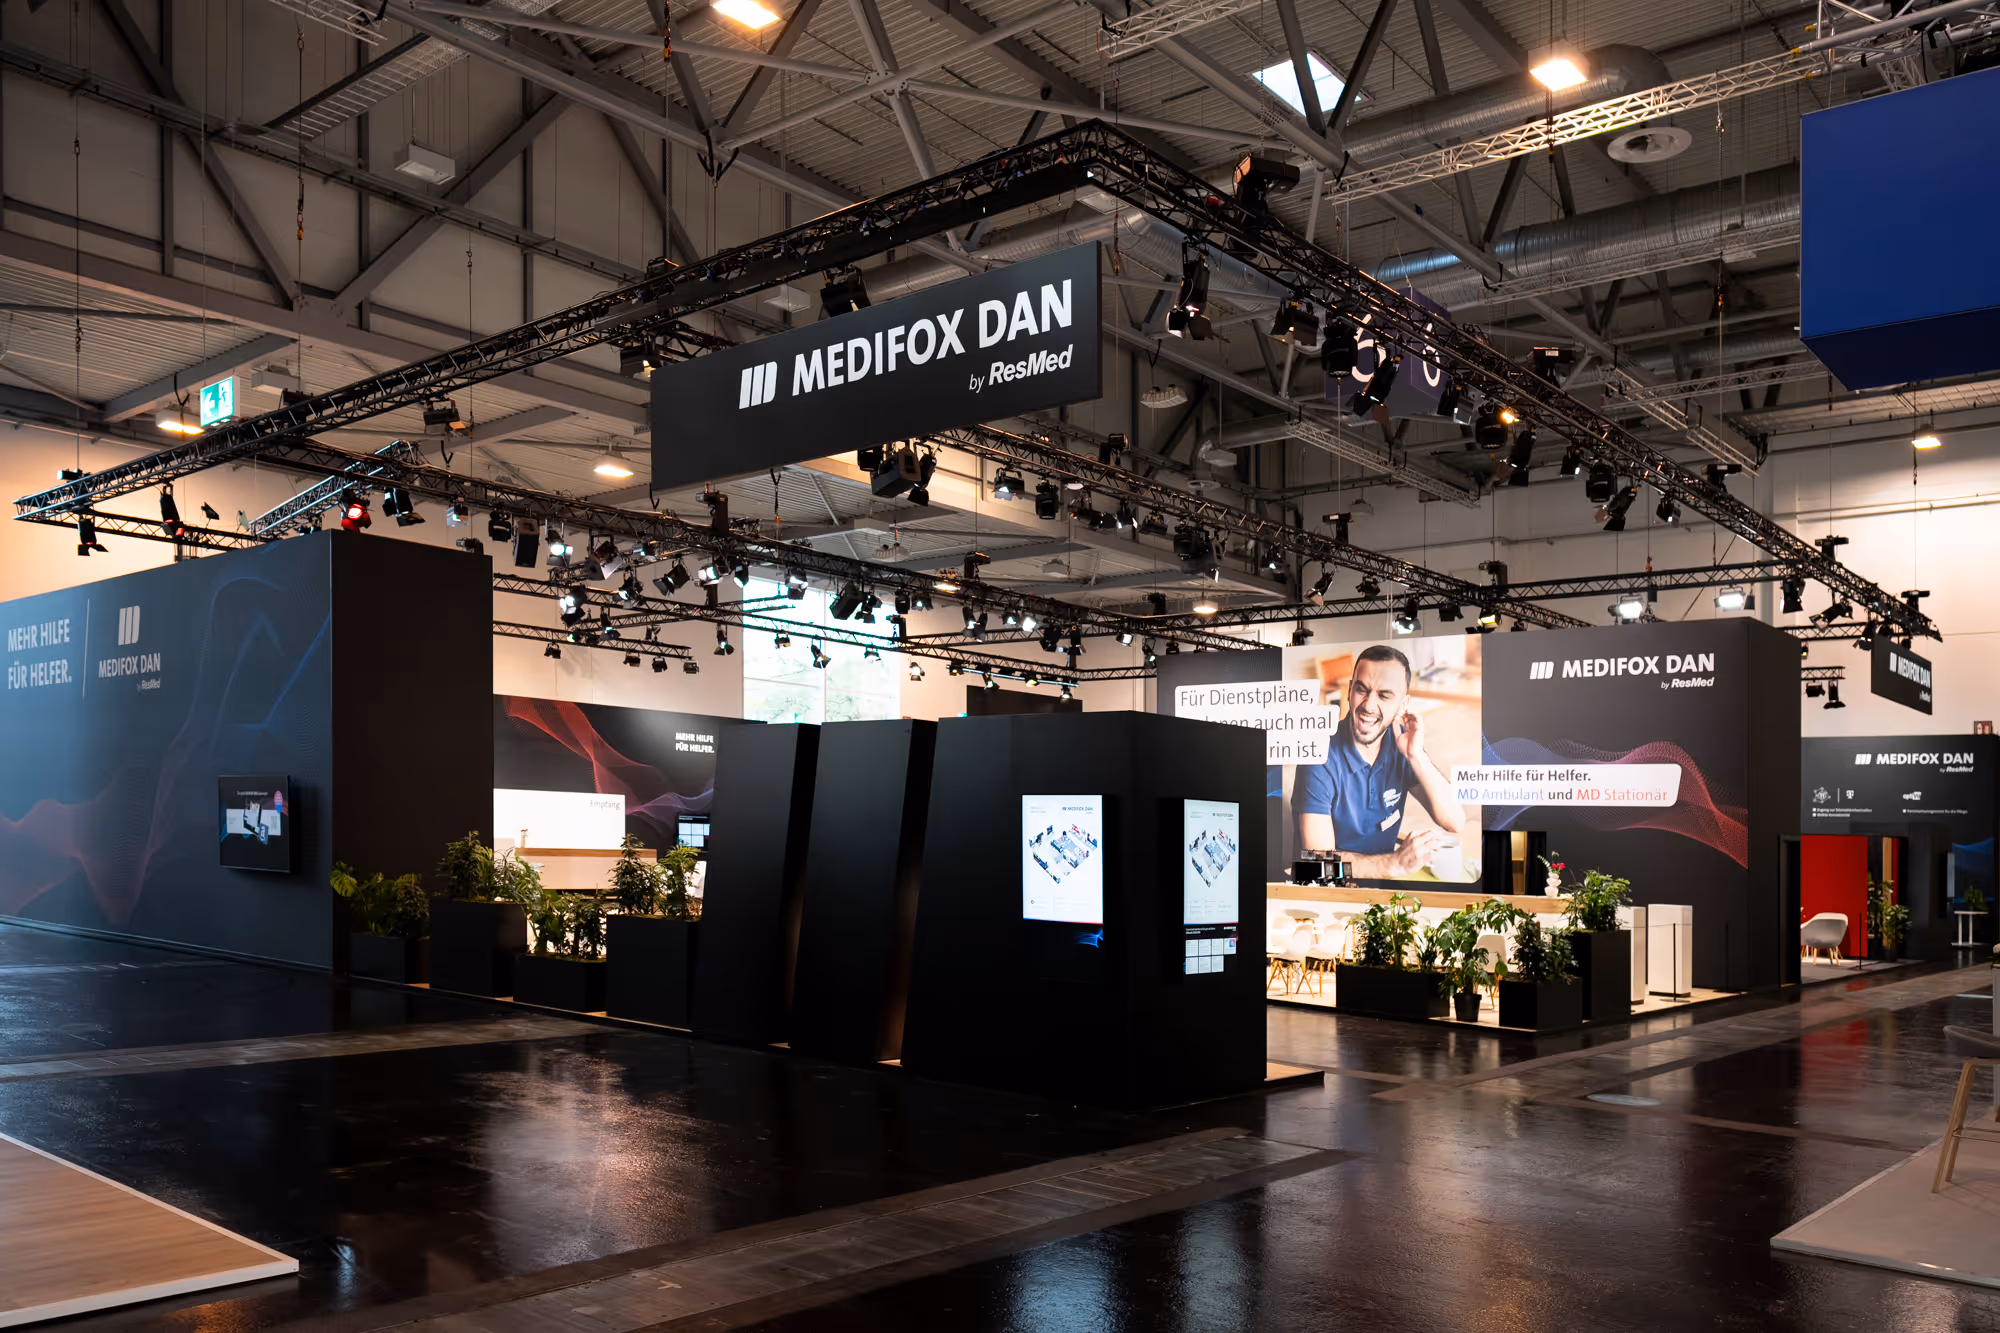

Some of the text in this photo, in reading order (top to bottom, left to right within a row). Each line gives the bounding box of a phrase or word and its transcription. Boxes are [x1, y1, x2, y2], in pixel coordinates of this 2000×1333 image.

[792, 278, 1073, 396] MEDIFOX DAN
[969, 344, 1073, 393] by ResMed
[8, 618, 70, 652] MEHR HILFE
[8, 658, 72, 690] FÜR HELFER.
[98, 652, 161, 678] MEDIFOX DAN
[1562, 653, 1715, 679] MEDIFOX DAN
[1661, 677, 1715, 690] by ResMed
[1181, 685, 1314, 709] Für Dienstpläne,
[1254, 713, 1294, 731] auch
[1300, 711, 1332, 730] mal
[675, 732, 714, 743] MEHR HILFE
[675, 741, 689, 752] FÜR
[1269, 740, 1322, 758] rin ist.
[1876, 753, 1974, 765] MEDIFOX DAN
[1457, 770, 1591, 781] Mehr Hilfe für Helfer.
[1457, 788, 1668, 800] MD Ambulant und MD Stationär
